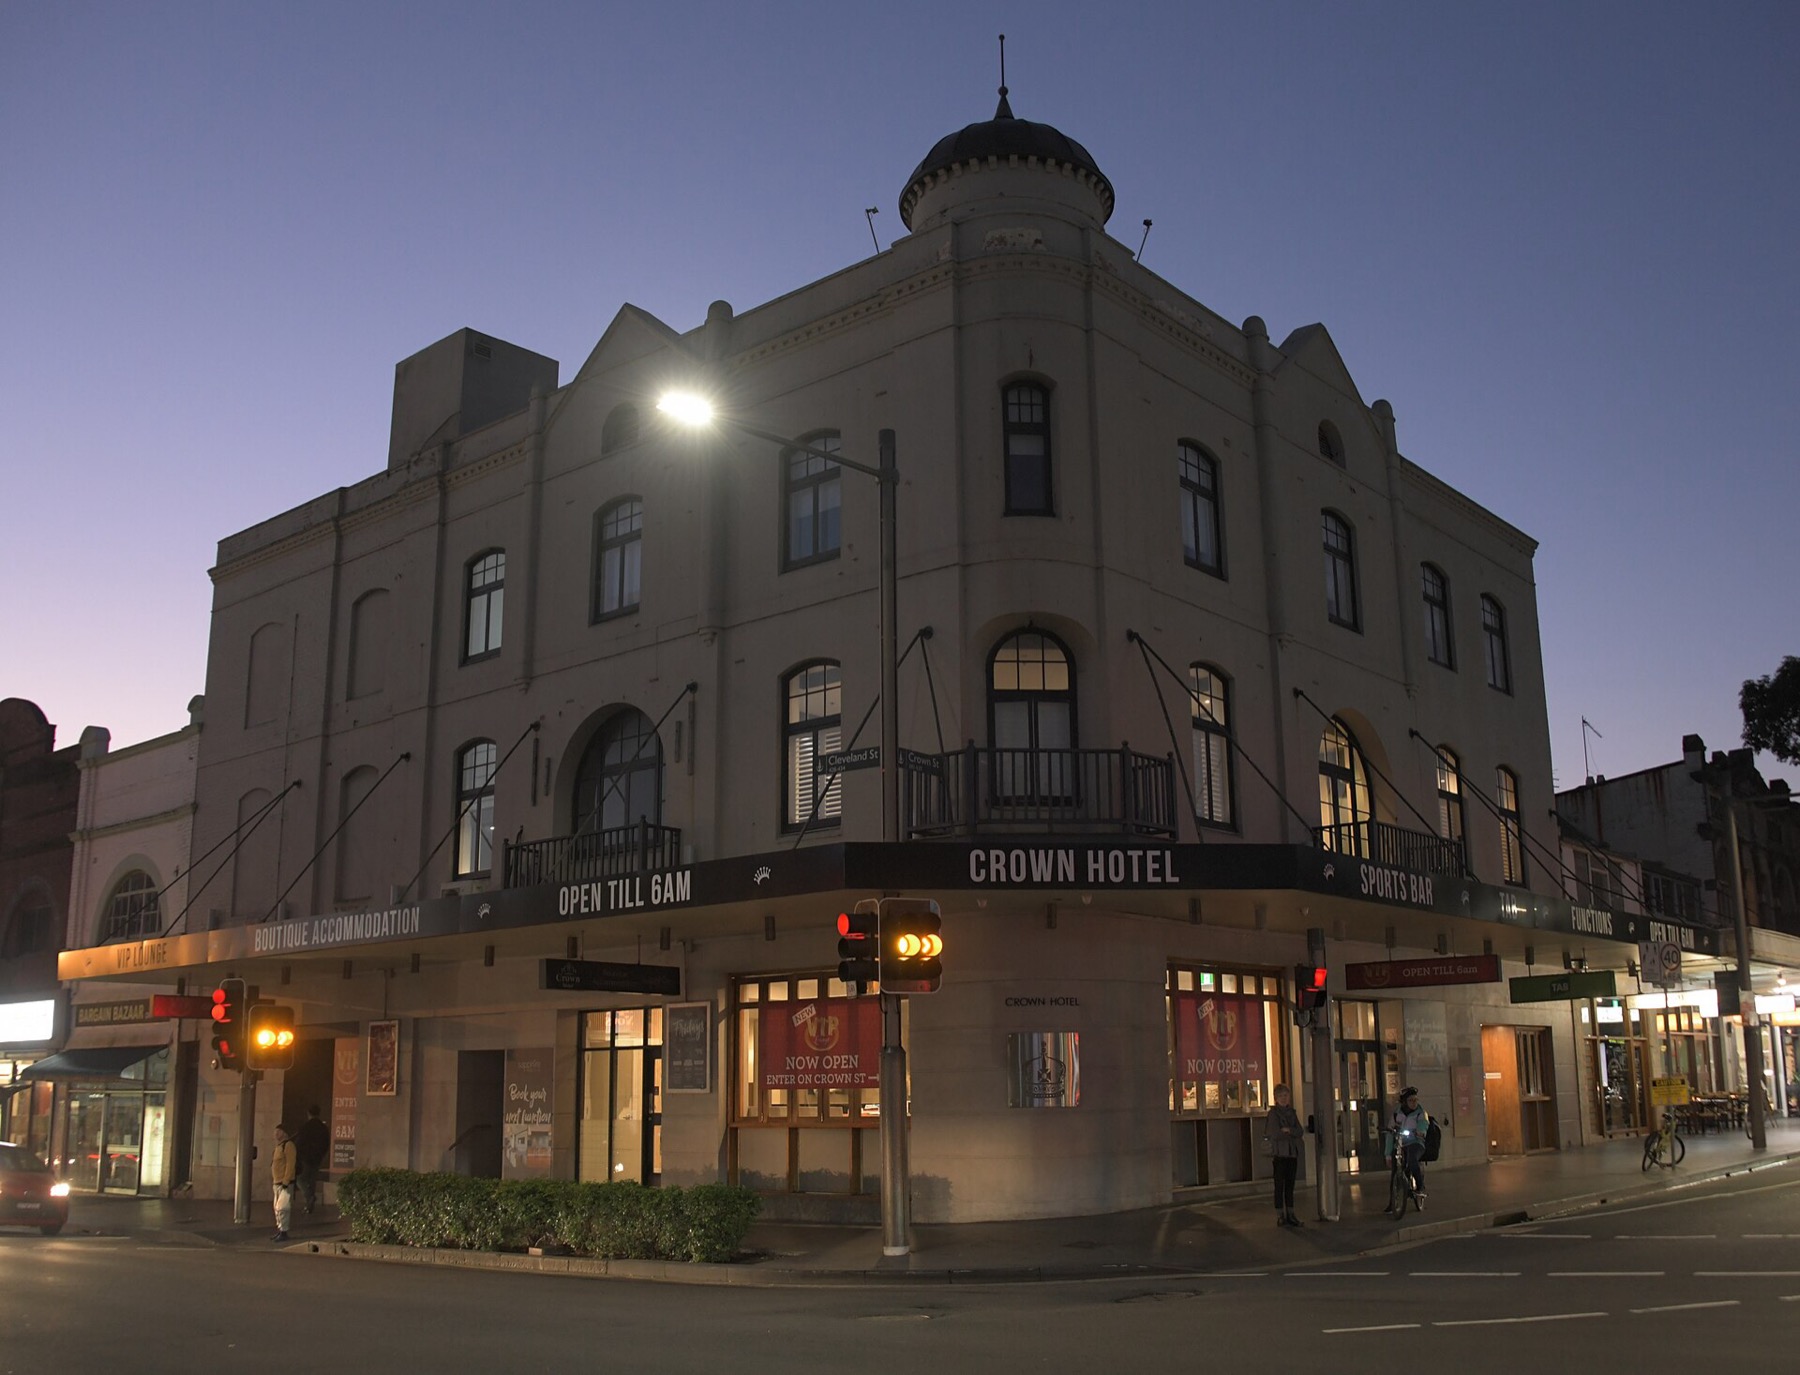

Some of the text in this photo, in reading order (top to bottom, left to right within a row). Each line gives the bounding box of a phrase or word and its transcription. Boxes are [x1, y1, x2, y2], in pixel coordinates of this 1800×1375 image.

[828, 748, 879, 766] Cleveland St
[907, 752, 931, 766] Crown
[932, 758, 940, 769] St
[969, 848, 1181, 885] CROWN HOTEL
[559, 869, 692, 917] OPEN TILL 6AM
[1359, 862, 1434, 906] SPORTS BAR
[1499, 891, 1518, 920] TAB
[1570, 905, 1613, 935] FUNCTIONS
[255, 906, 420, 953] BOUTIQUE ACCOMMODATION
[1649, 921, 1667, 942] OPEN
[116, 943, 168, 969] VIP LOUNGE
[1664, 950, 1679, 964] 40
[1402, 965, 1478, 977] OPEN TILL 6am
[1551, 982, 1569, 992] TAB
[1005, 997, 1080, 1007] CROWN HOTEL
[1199, 1001, 1214, 1017] NEW
[78, 1007, 112, 1023] BARGAIN
[112, 1004, 145, 1021] BAZAAR
[794, 1006, 815, 1024] NEW
[1208, 1010, 1237, 1034] VIP
[806, 1015, 840, 1037] VIP
[785, 1054, 859, 1070] NOW OPEN
[1187, 1059, 1245, 1074] NOW OPEN
[766, 1073, 866, 1085] ENTER ON CROWN ST
[508, 1083, 547, 1108] Book your
[506, 1107, 521, 1124] next
[335, 1125, 355, 1138] 6AM
